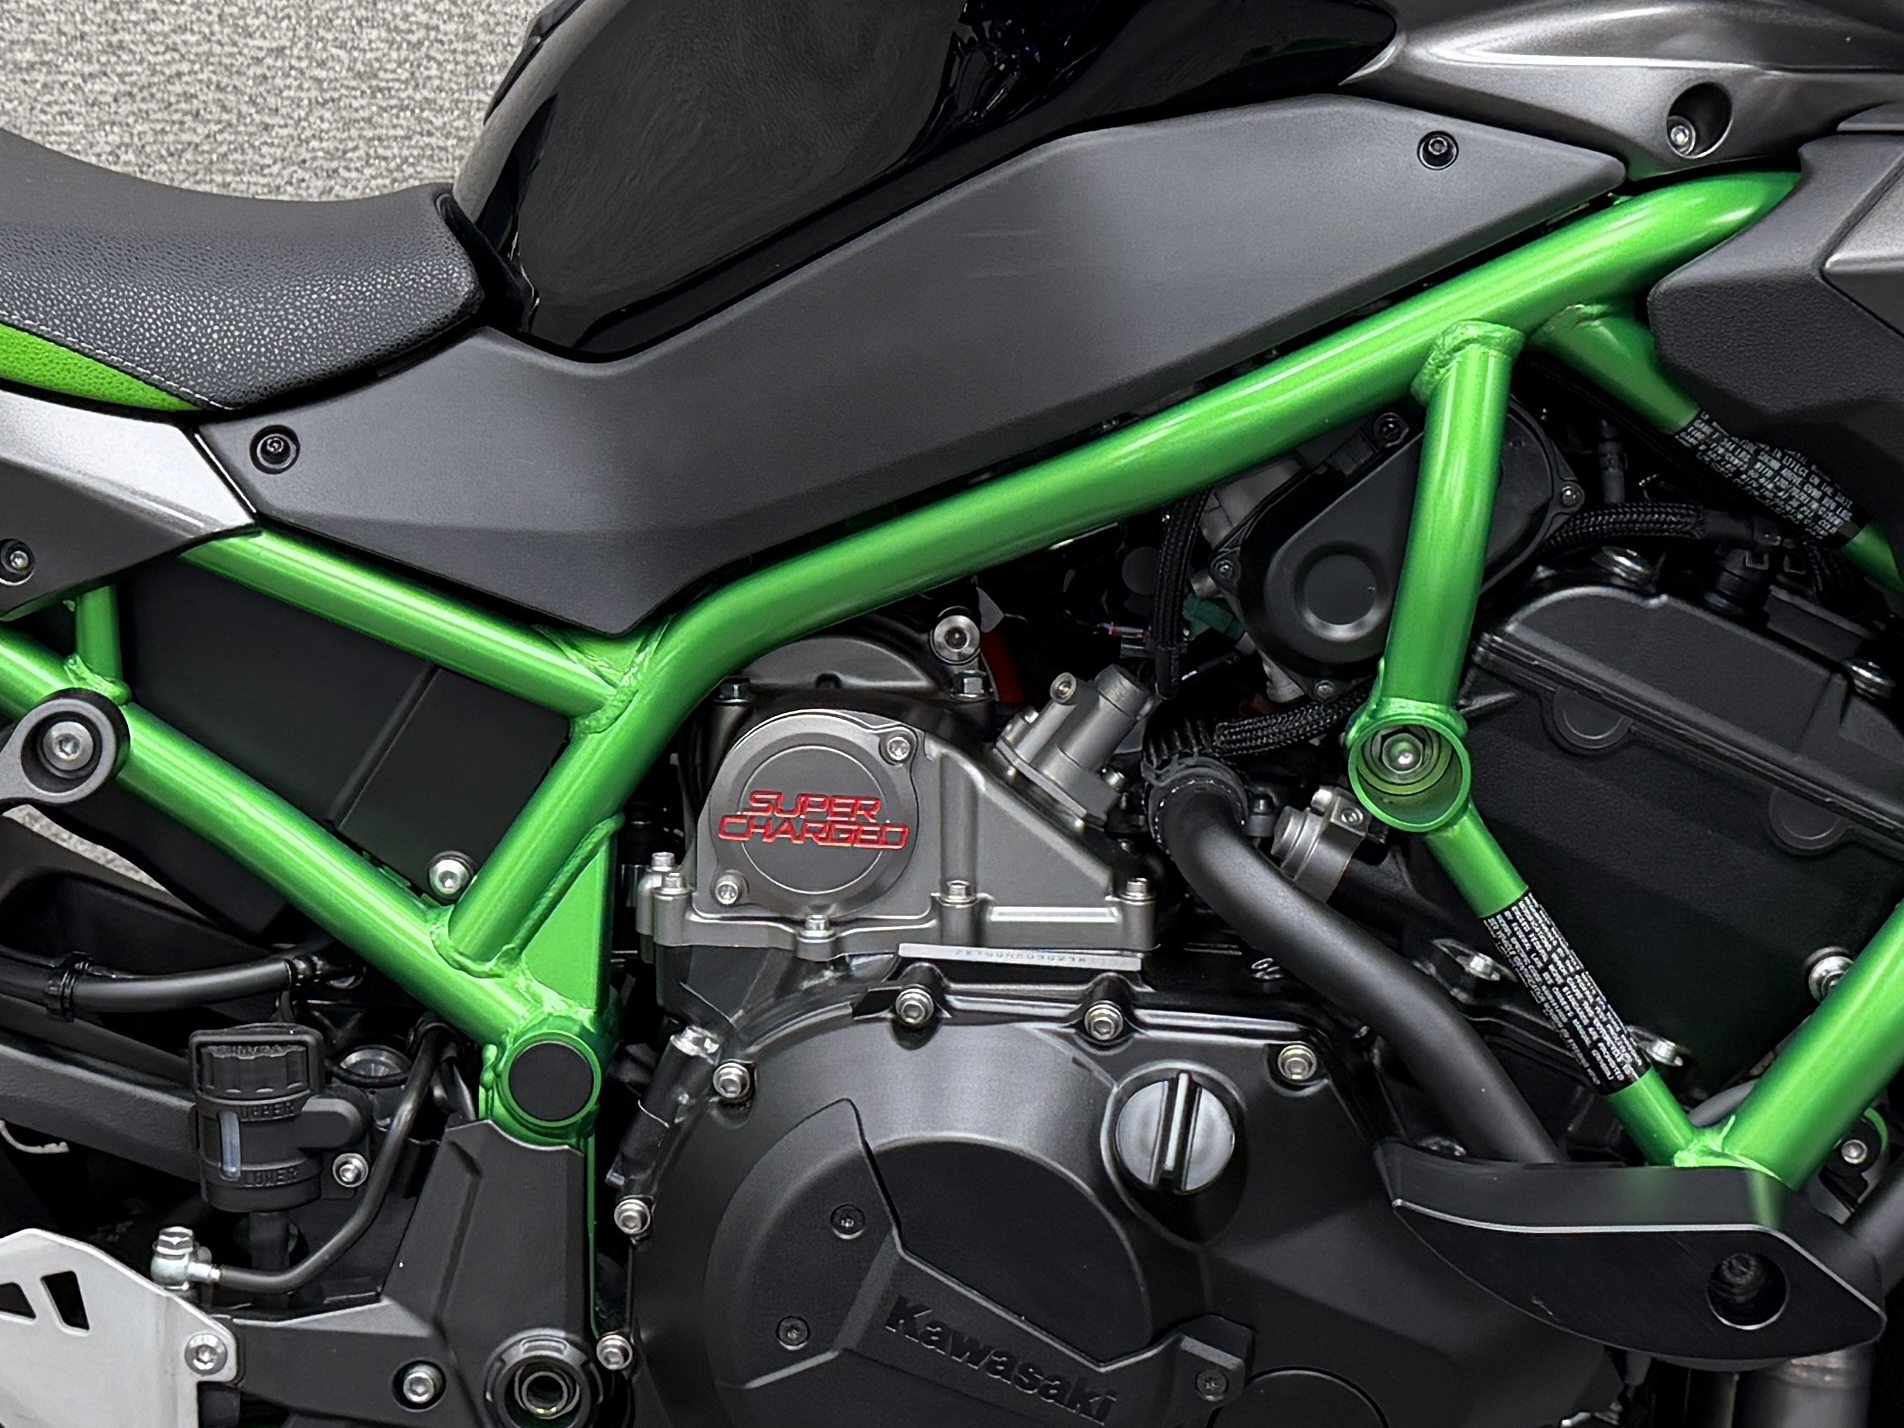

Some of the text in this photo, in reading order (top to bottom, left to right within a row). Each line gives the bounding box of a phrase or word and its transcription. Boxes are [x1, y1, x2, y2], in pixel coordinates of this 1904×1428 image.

[747, 790, 882, 824] SUPER
[718, 815, 909, 850] CHARGED
[885, 1296, 1118, 1428] Kawasaki
